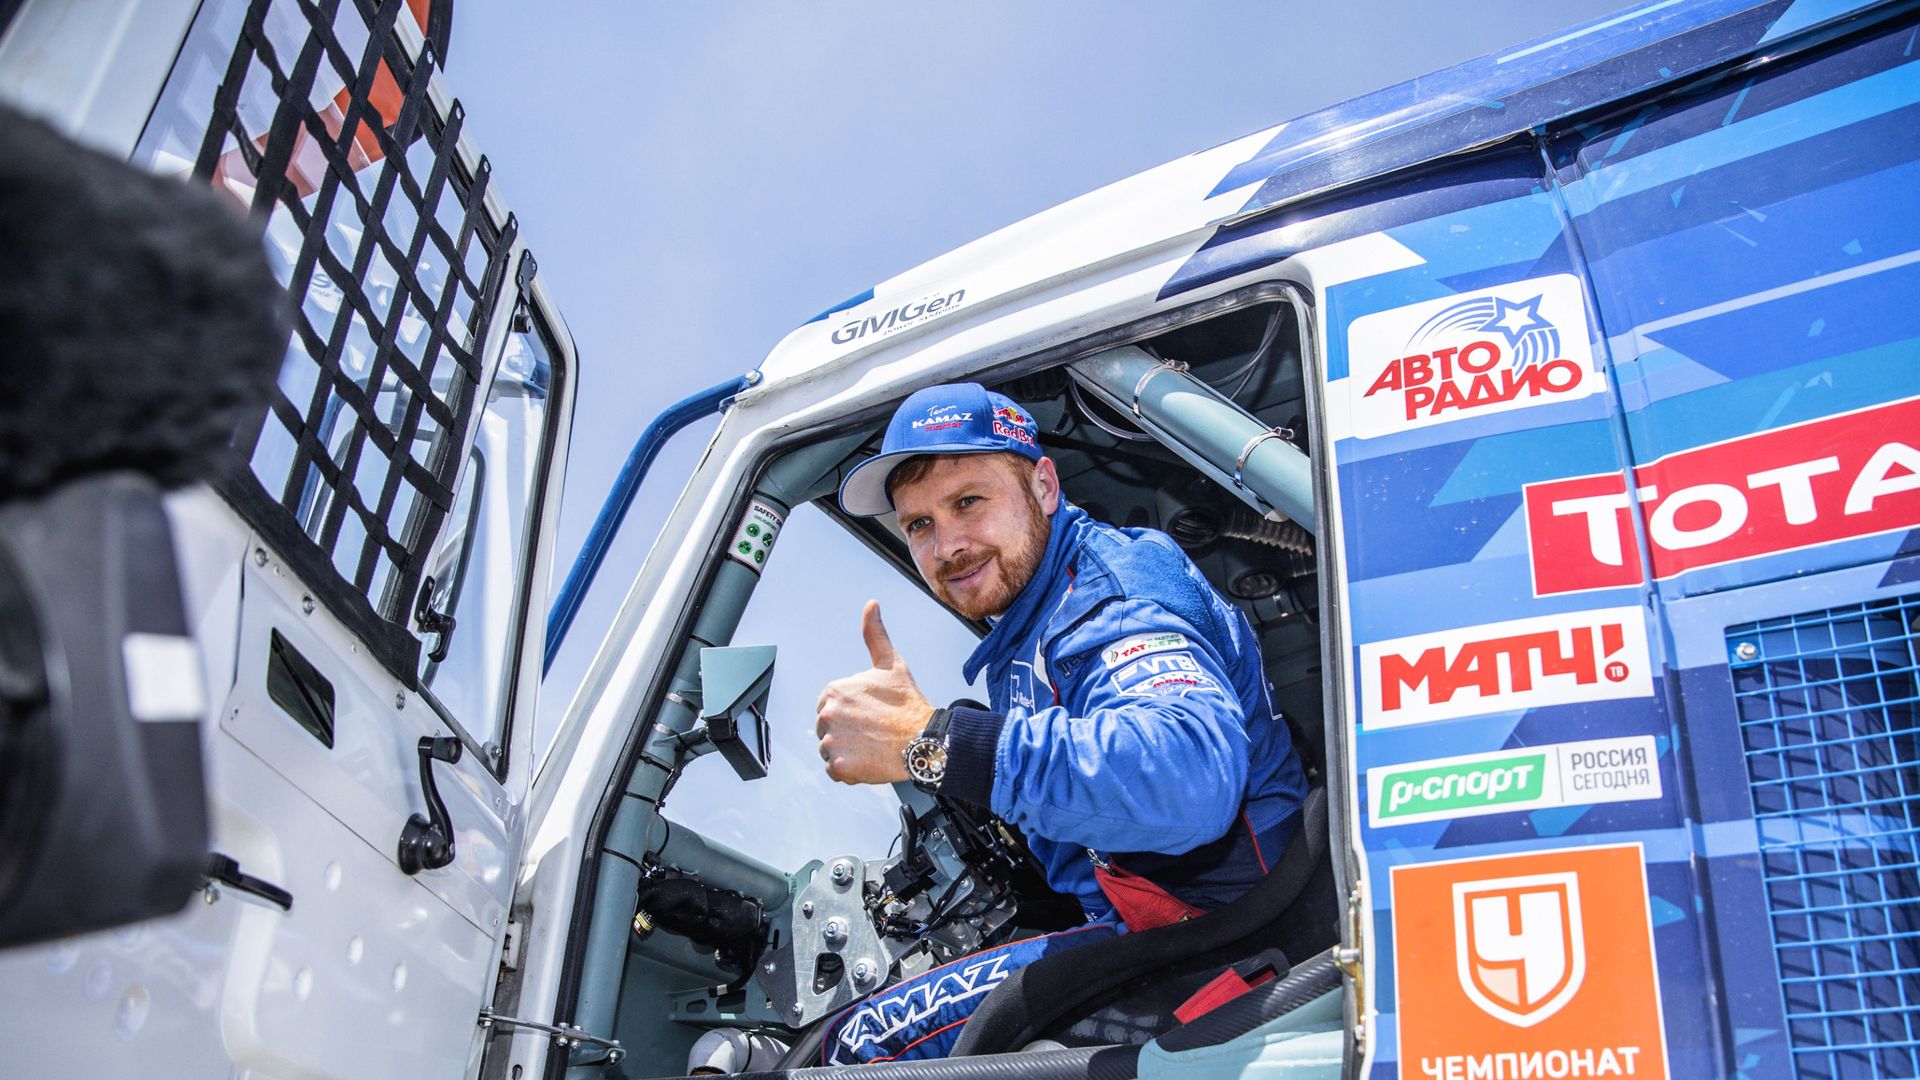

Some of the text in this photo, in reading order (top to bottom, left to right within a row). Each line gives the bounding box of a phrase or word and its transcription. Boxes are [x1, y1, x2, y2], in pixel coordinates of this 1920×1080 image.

[1363, 340, 1502, 398] АВТО
[1404, 359, 1583, 421] РАДИО
[912, 412, 973, 429] KAMAZ
[993, 420, 1019, 440] Red
[754, 505, 776, 521] SAFETY
[1139, 655, 1197, 675] VTB
[1571, 747, 1648, 771] РОССИЯ
[1573, 768, 1651, 791] СЕГОДНЯ
[1421, 1046, 1641, 1080] ЧЕМПИОНАТ
